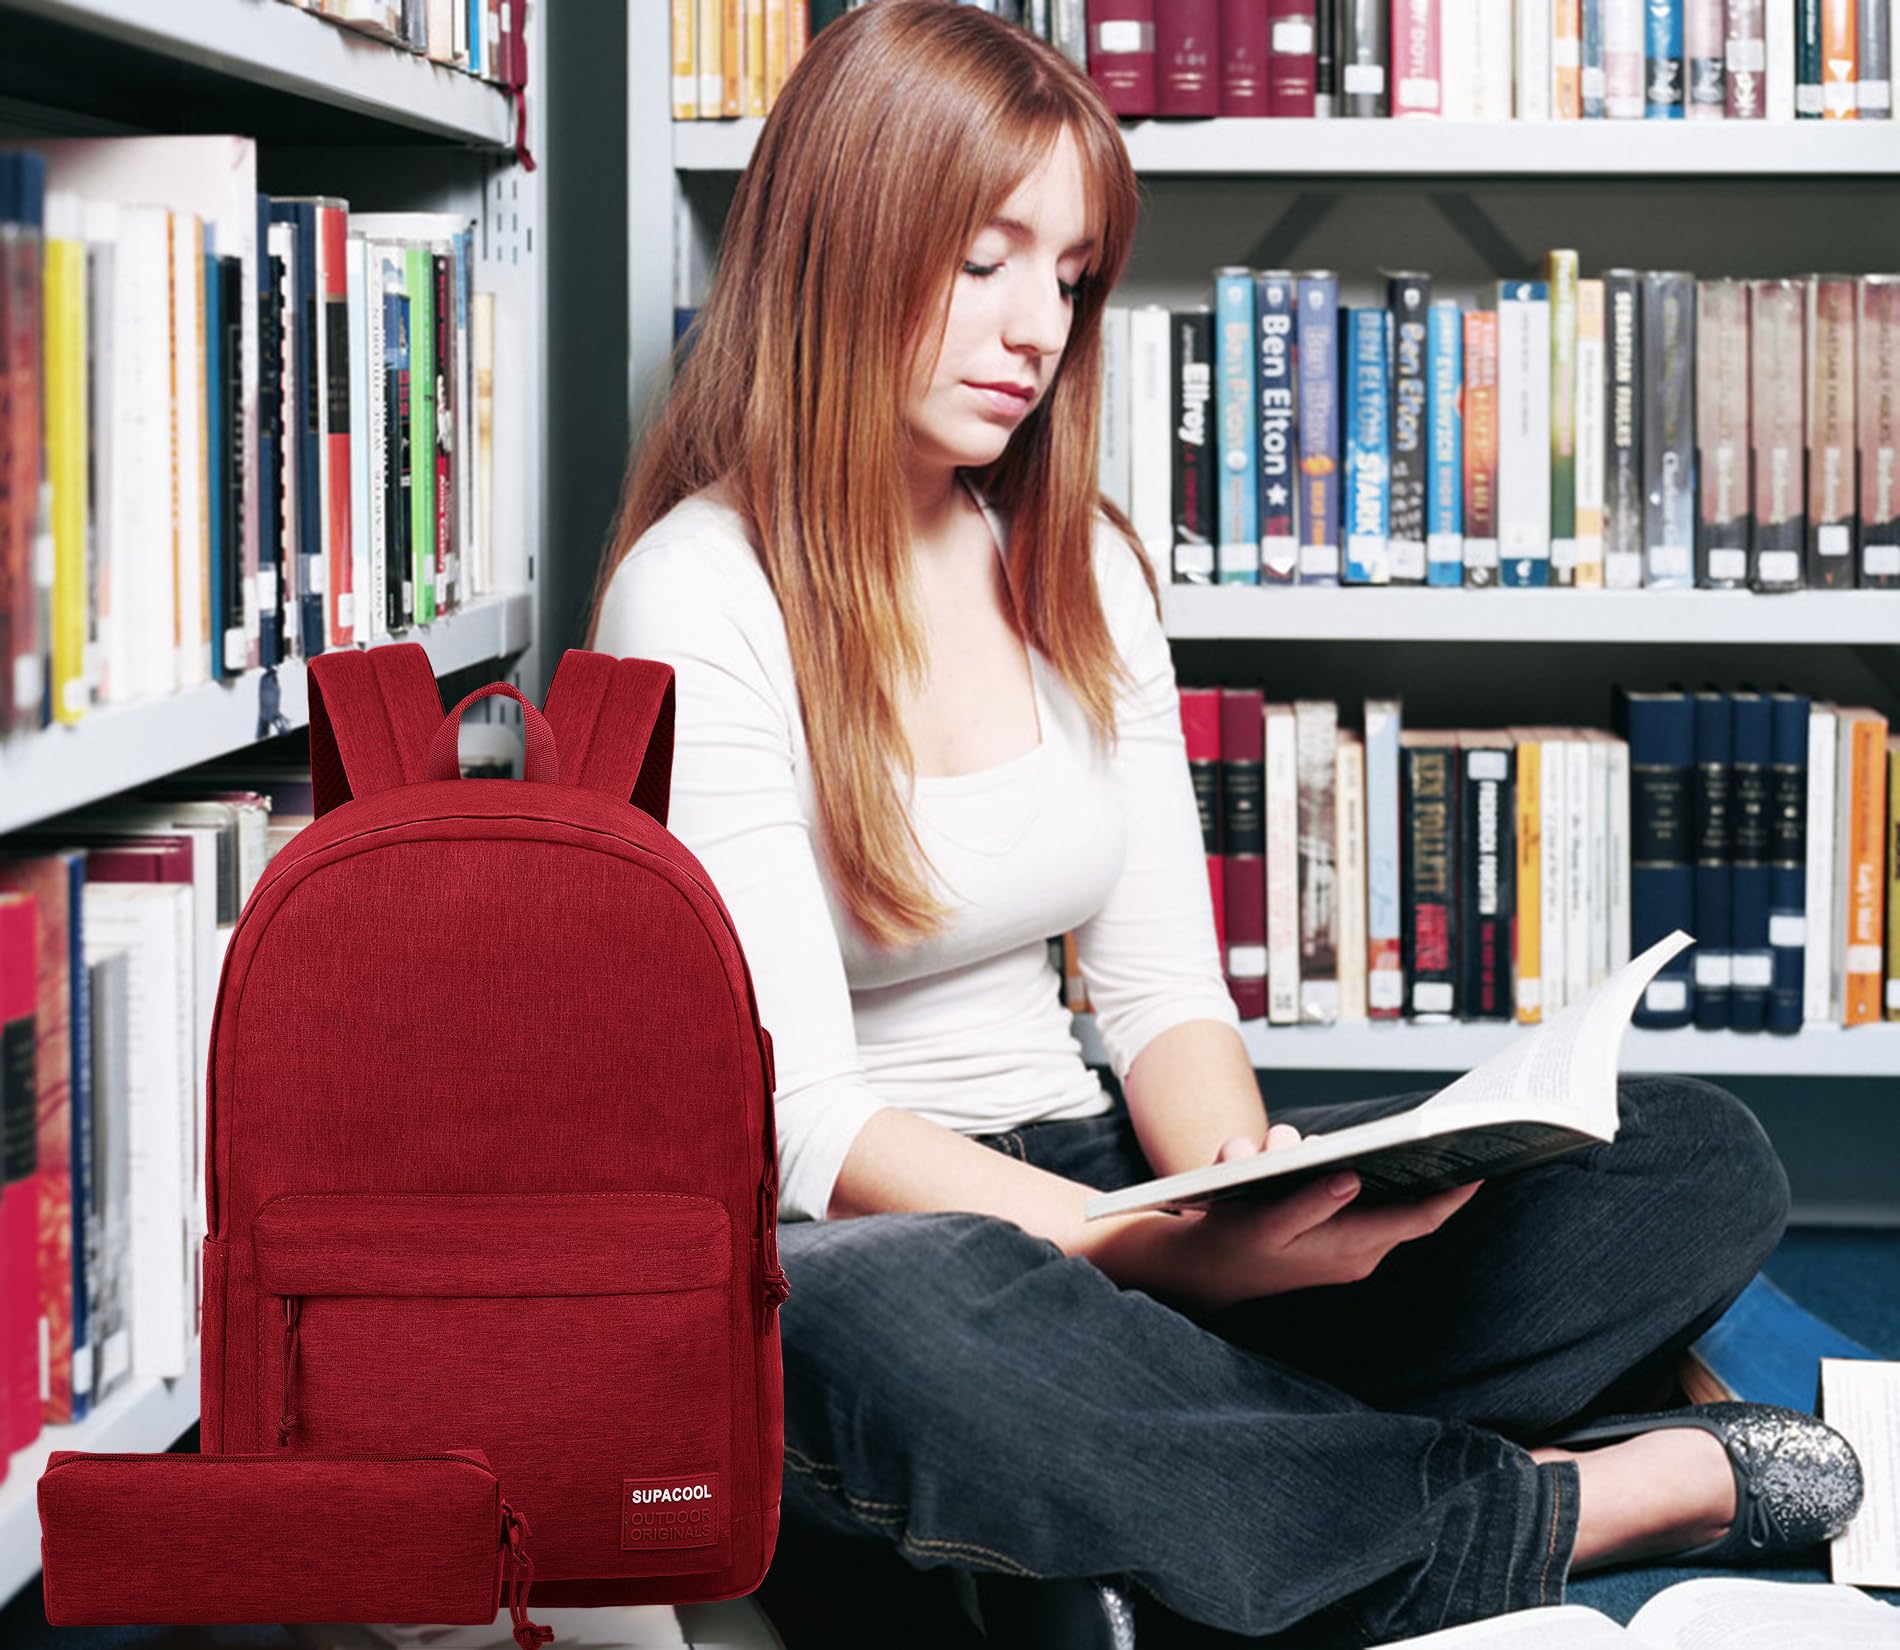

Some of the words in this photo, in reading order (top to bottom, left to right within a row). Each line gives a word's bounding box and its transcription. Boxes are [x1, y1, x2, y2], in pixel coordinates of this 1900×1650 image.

[1262, 313, 1291, 378] Ben
[1358, 312, 1380, 363] BEN
[1398, 321, 1425, 375] Ben
[1614, 291, 1633, 382] SEBASTIAN
[1178, 362, 1210, 445] Ellroy
[1262, 387, 1292, 476] Elton
[1396, 378, 1424, 452] Elton
[1614, 386, 1632, 448] FAULKS
[1355, 451, 1384, 535] STARK
[1413, 752, 1447, 798] KEN
[1413, 801, 1447, 895] FOLLETT
[631, 1508, 711, 1525] OUTDOOR
[632, 1484, 712, 1503] SUPACOOL
[630, 1524, 712, 1541] ORIGINALS
